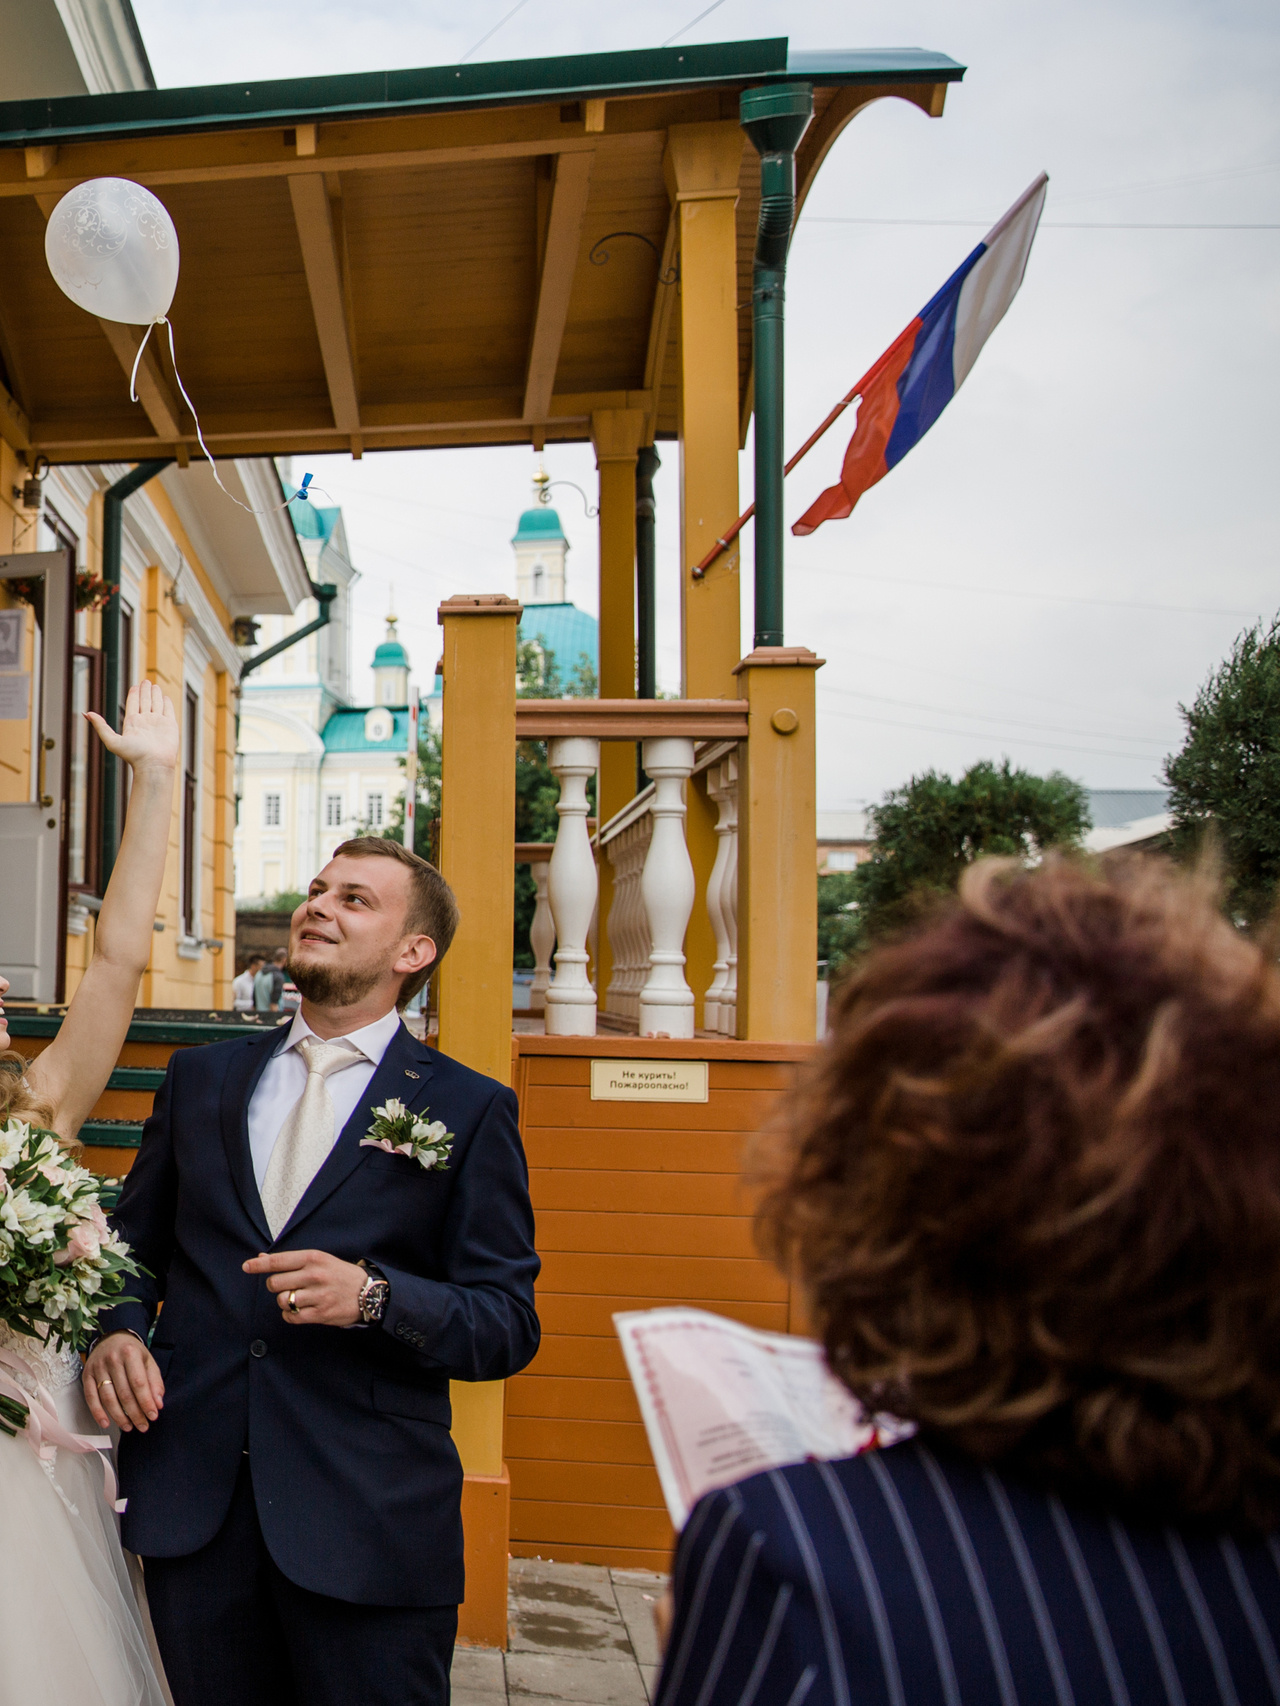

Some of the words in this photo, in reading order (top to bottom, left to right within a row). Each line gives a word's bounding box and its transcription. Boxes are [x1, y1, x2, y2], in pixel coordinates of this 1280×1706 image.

[622, 1070, 636, 1079] Не
[638, 1071, 677, 1080] курить!
[609, 1080, 689, 1090] Пожароопасно!
